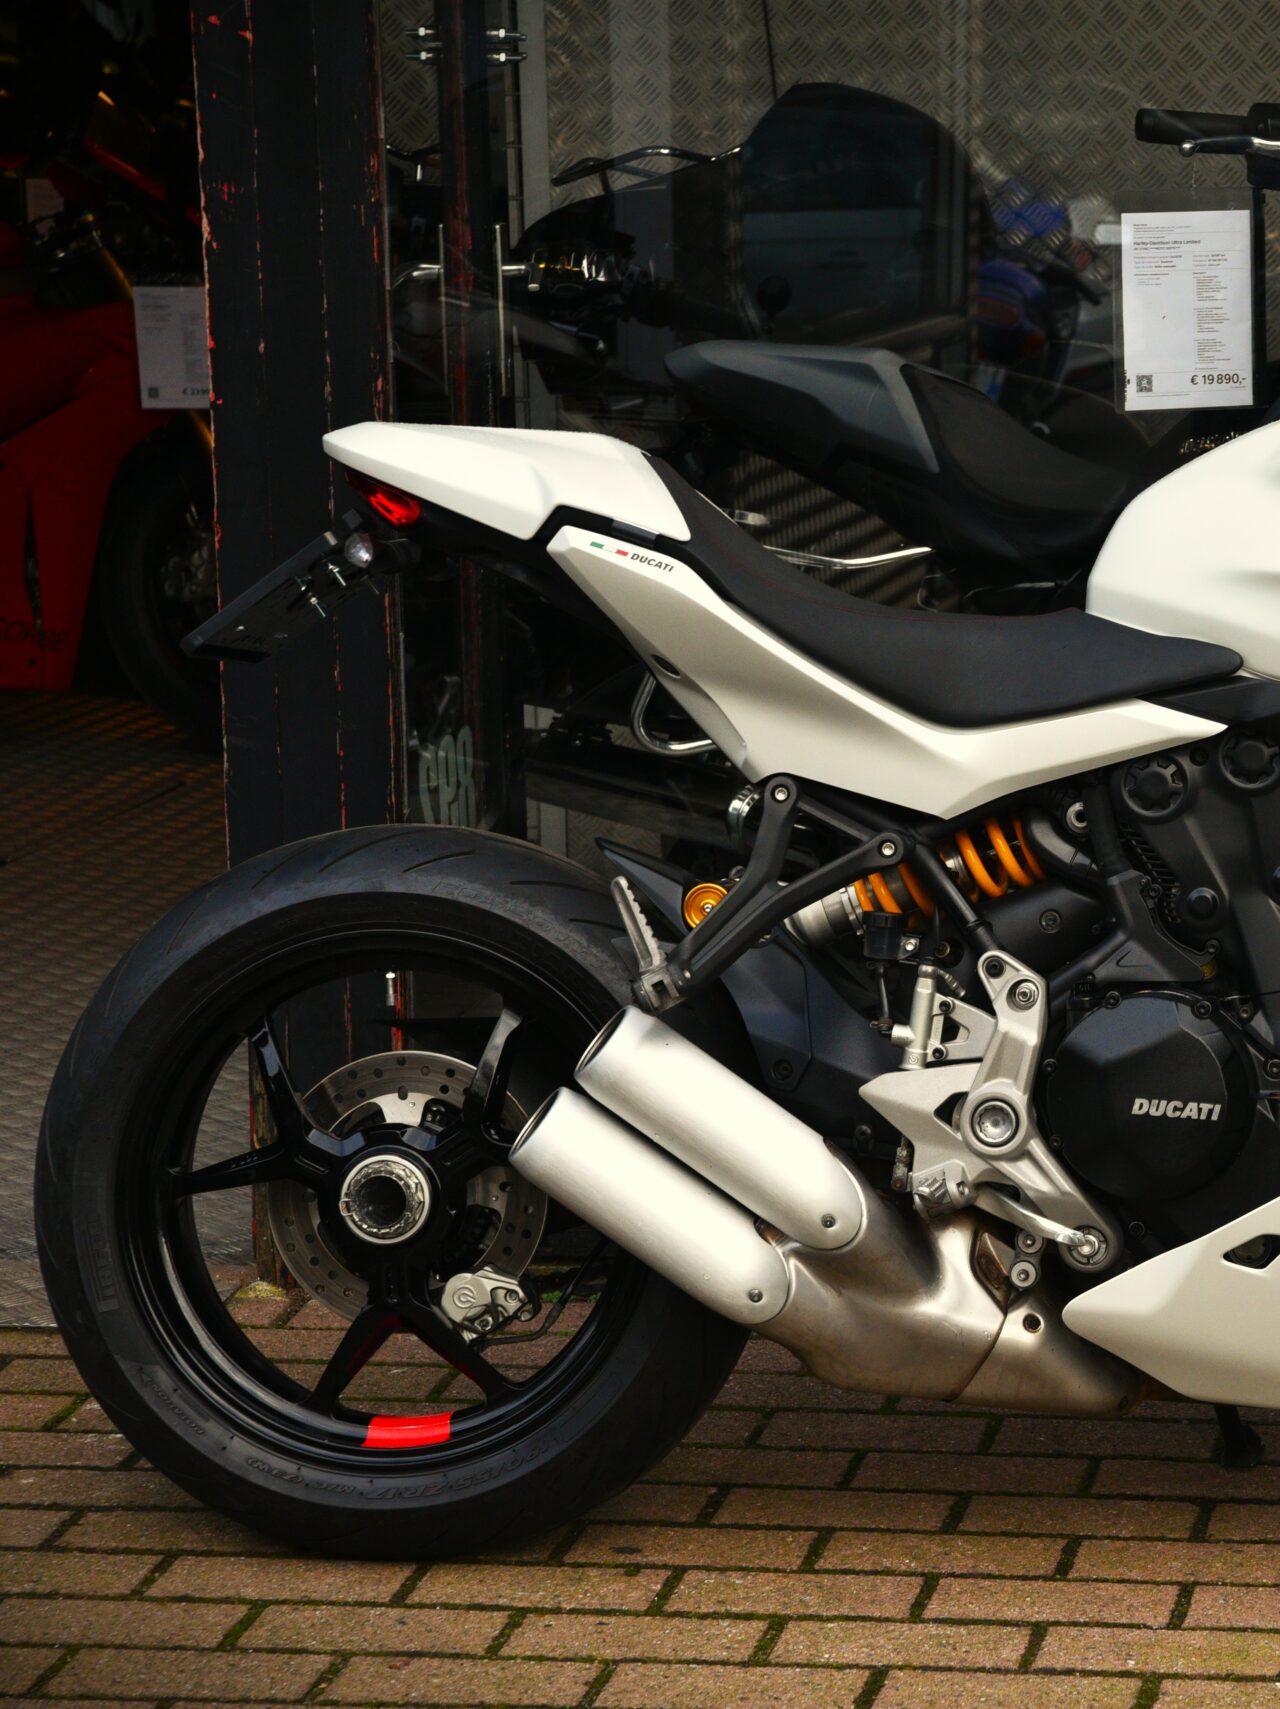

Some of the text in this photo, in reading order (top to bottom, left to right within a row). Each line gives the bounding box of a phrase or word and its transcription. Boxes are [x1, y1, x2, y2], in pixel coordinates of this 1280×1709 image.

[1191, 374, 1199, 385] €
[630, 552, 675, 573] DUCATI
[1131, 1097, 1222, 1121] DUCATI
